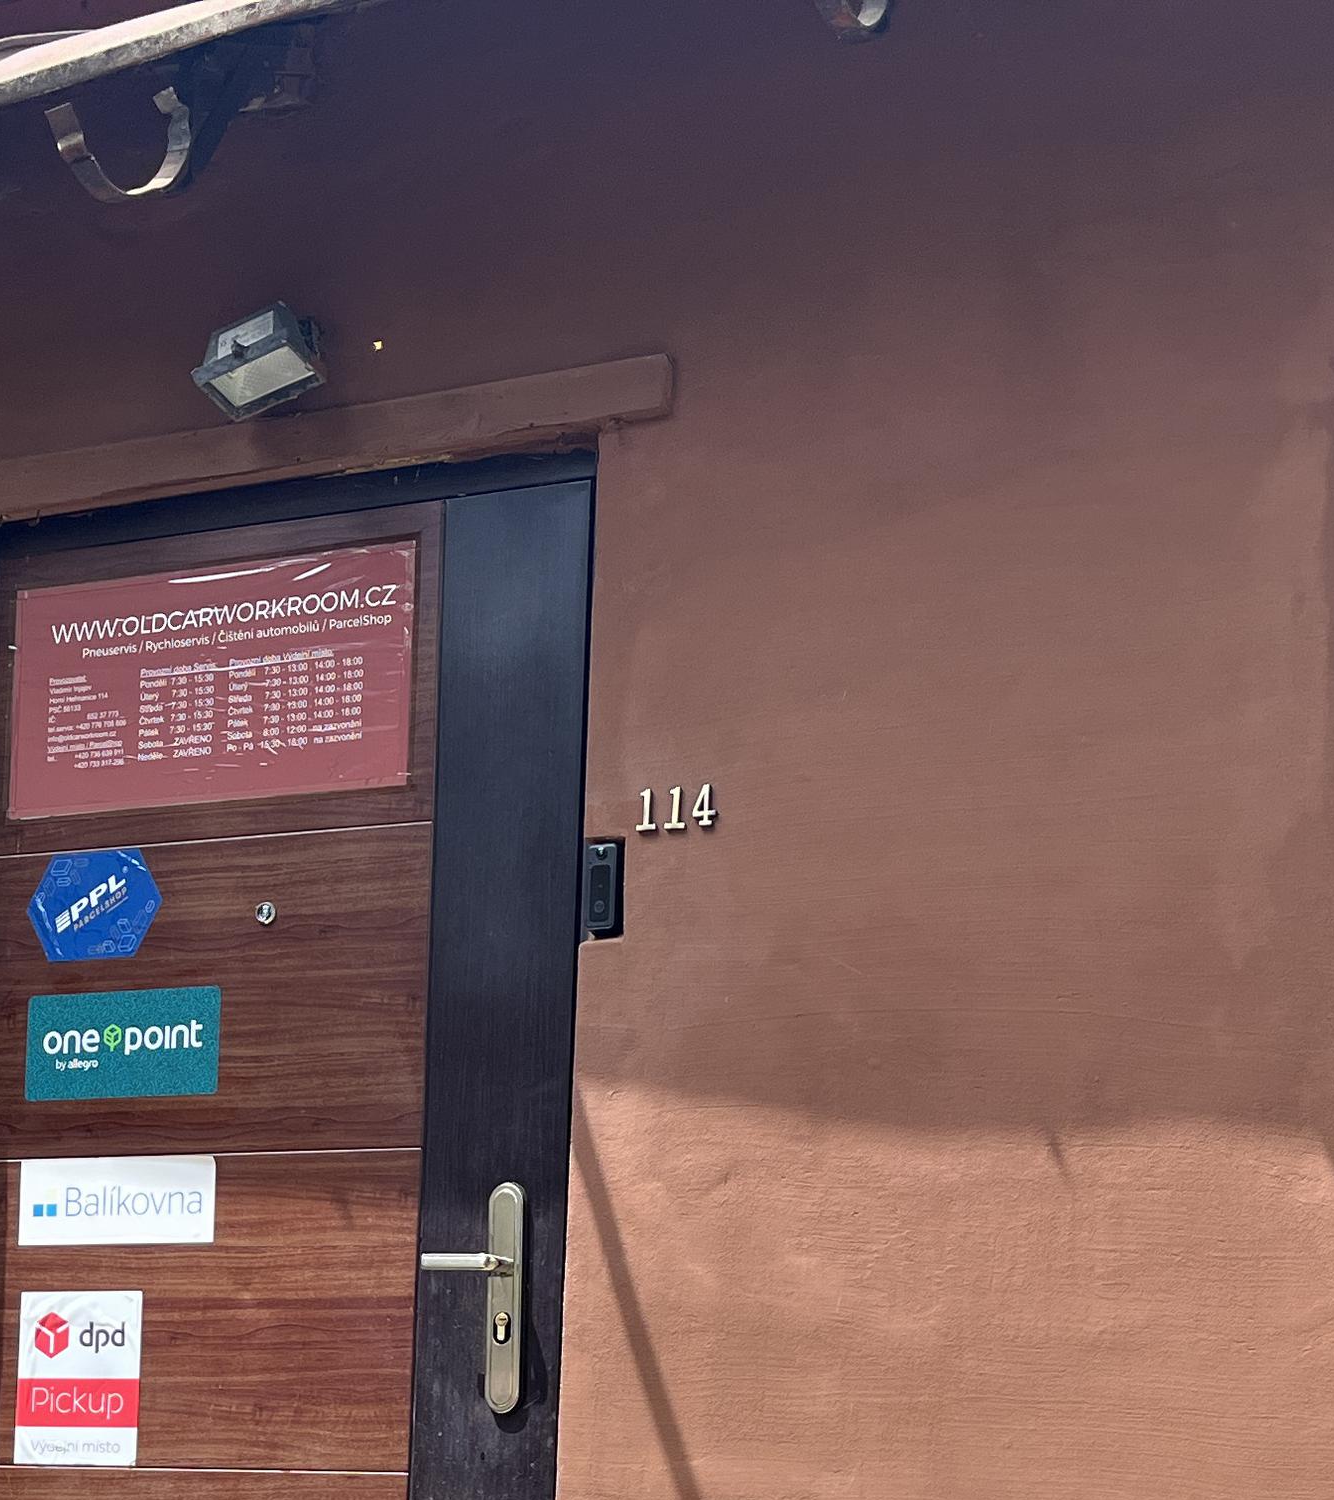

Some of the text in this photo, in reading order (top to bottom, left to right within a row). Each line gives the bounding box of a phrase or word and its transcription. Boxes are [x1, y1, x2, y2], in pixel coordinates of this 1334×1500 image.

[51, 584, 397, 644] WWW.OLDCARWORKROOM.CZ
[82, 614, 392, 659] Pneuservis / Rychloservis / Čištění automobilů / ParcelShop
[174, 664, 192, 675] doba
[229, 668, 256, 679] Pondělí
[264, 666, 281, 675] 7:30
[315, 659, 335, 669] 14:00
[342, 656, 363, 666] 18:00
[263, 655, 281, 665] doba
[140, 678, 167, 689] Pondělí
[171, 676, 187, 686] 7:30
[194, 673, 215, 683] 15:30
[229, 681, 248, 691] Úterý
[265, 678, 282, 687] 7:30
[316, 672, 336, 682] 14:00
[343, 669, 364, 679] 18:00
[140, 691, 160, 702] Úterý
[171, 688, 187, 698] 7:30
[194, 685, 215, 695] 15:30
[228, 694, 252, 703] Středa
[265, 690, 281, 700] 7:30
[315, 684, 335, 694] 14:00
[343, 681, 363, 691] 18:00
[139, 702, 163, 714] Středa
[171, 701, 187, 710] 7:30
[194, 697, 215, 707] 15:30
[228, 706, 253, 716] Čtvrtek
[263, 702, 281, 712] 7:30
[314, 696, 334, 706] 14:00
[139, 715, 165, 726] Čtvrtek
[170, 713, 187, 722] 7:30
[194, 710, 214, 720] 15:30
[227, 718, 248, 728] Pátek
[263, 715, 280, 724] 7:30
[313, 709, 334, 719] 14:00
[138, 728, 159, 737] Pátek
[170, 725, 186, 734] 7:30
[193, 722, 213, 732] 15:30
[227, 730, 253, 740] Sobota
[263, 727, 280, 737] 8:00
[287, 724, 307, 734] 12:00
[138, 734, 213, 750] Sobota ZAVŘENO
[227, 743, 237, 752] Po
[138, 746, 212, 761] Neděle ZAVŘENO
[635, 783, 717, 831] 114
[70, 875, 126, 922] PPL
[73, 887, 127, 932] PARCELSHOP
[43, 1019, 203, 1056] one point
[56, 1058, 99, 1071] by allegro
[65, 1185, 203, 1217] Balíkovna
[79, 1322, 125, 1354] dpd
[31, 1387, 124, 1420] Pickup
[82, 1438, 121, 1454] místo
